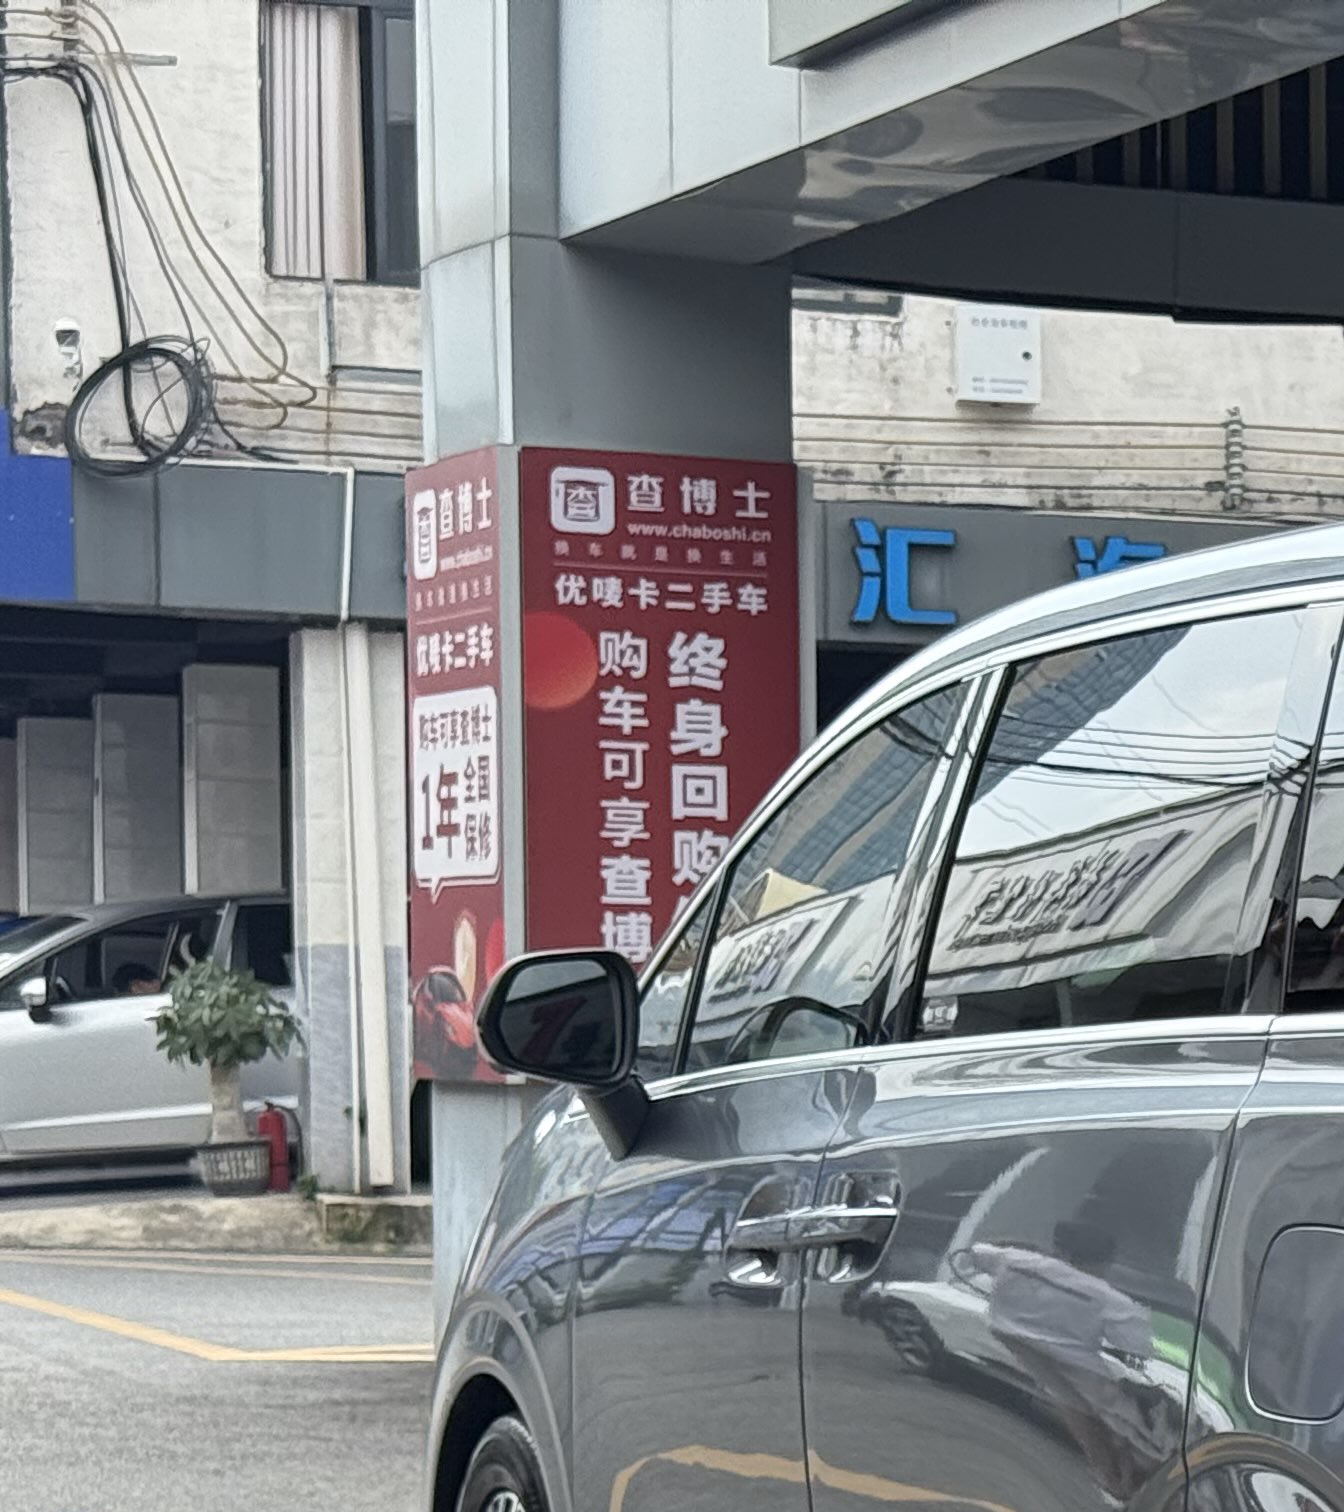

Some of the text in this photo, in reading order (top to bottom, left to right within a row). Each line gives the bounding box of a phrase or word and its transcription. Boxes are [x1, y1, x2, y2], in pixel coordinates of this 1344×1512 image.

[626, 474, 771, 519] 查博士
[627, 522, 772, 544] www.chaboshi.cn
[554, 573, 769, 616] 优唛卡二手车
[464, 755, 491, 803] 全国
[667, 630, 731, 920] 终身回购
[421, 762, 461, 859] 1年
